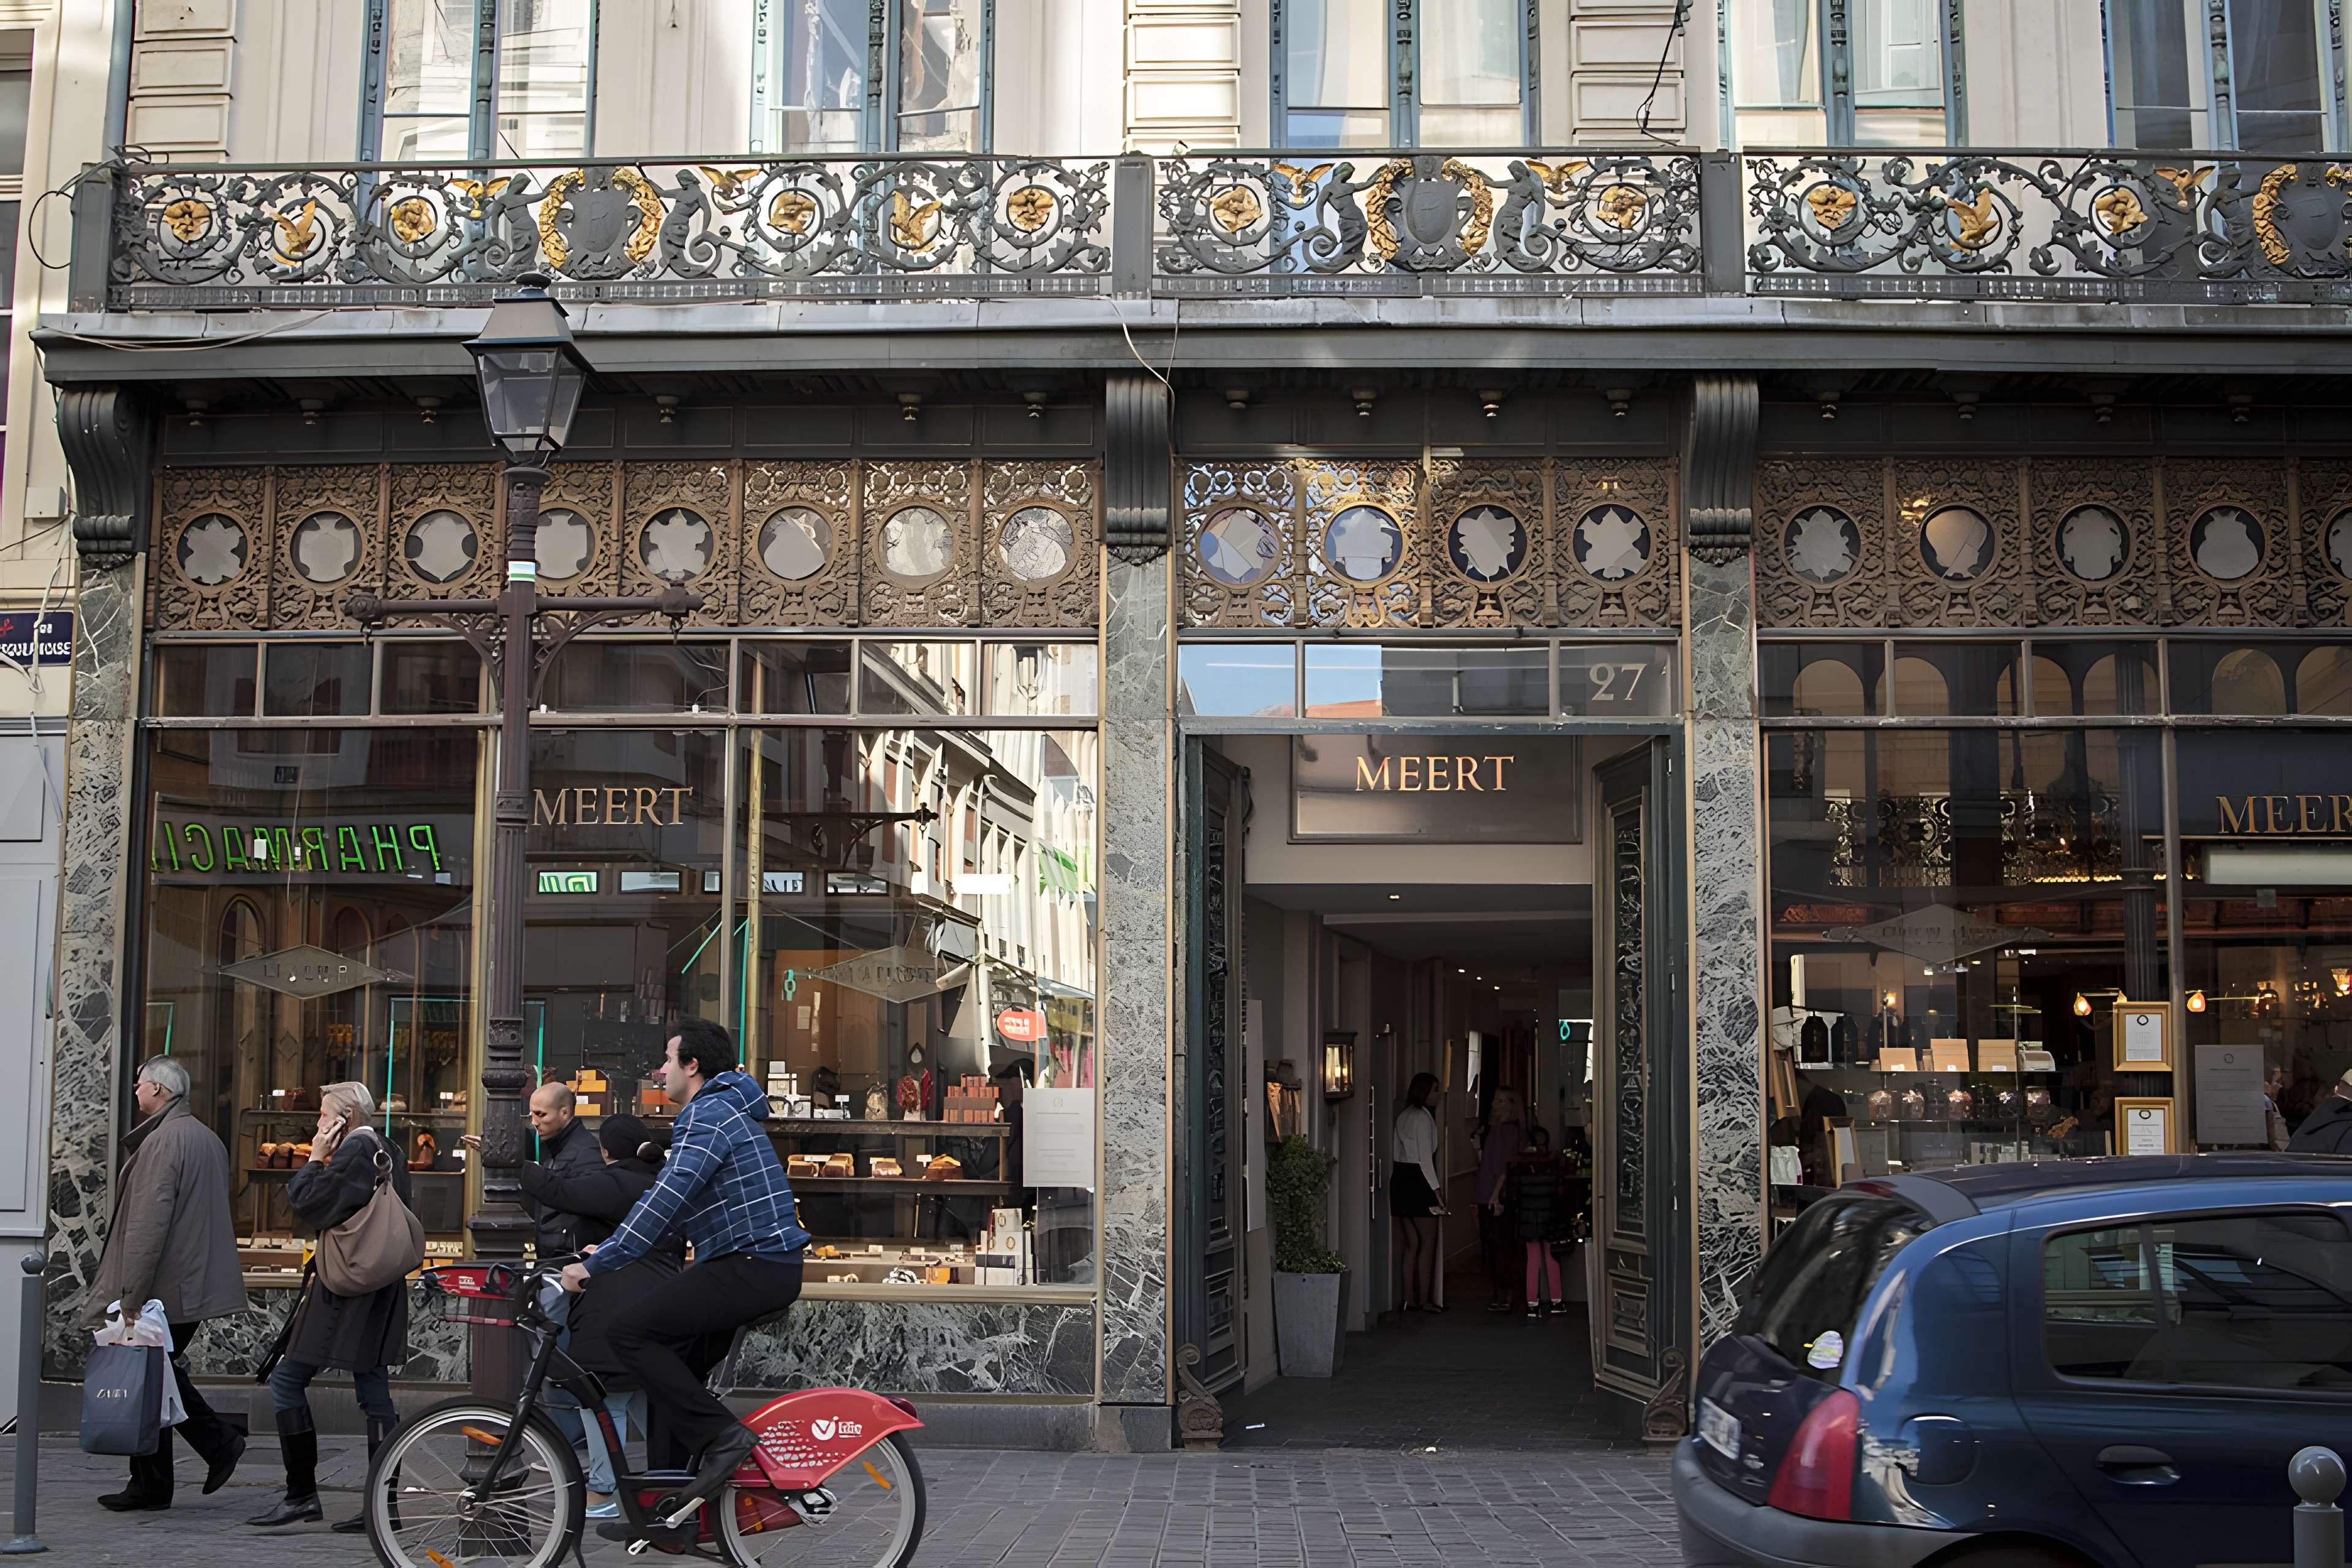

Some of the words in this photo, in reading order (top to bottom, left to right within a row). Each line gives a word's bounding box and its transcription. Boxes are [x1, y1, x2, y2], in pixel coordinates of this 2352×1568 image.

[1589, 663, 1647, 701] 27
[1355, 755, 1515, 791] MEERT
[531, 785, 693, 826] MEERT
